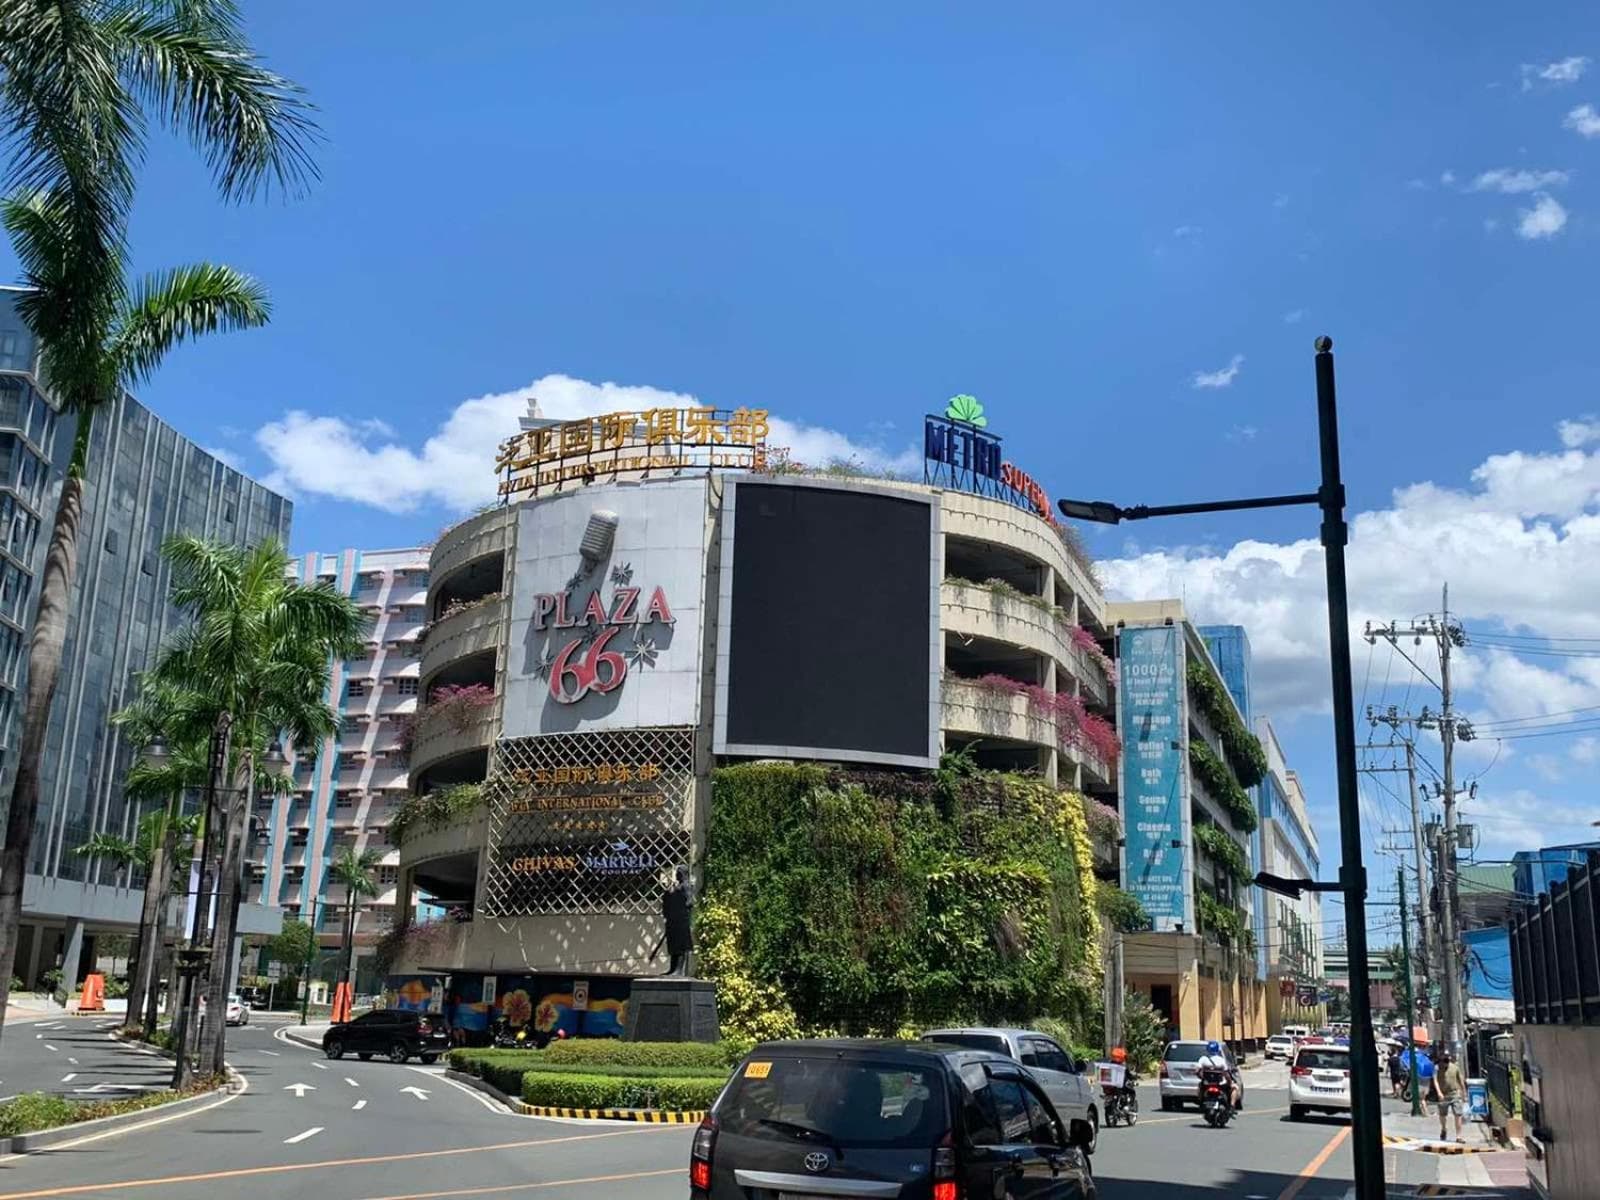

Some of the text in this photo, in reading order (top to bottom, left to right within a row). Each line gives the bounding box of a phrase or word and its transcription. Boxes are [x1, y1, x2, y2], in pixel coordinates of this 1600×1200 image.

[926, 421, 1001, 481] METRO
[532, 585, 676, 630] PLAZA
[549, 626, 628, 704] 66
[537, 795, 624, 811] INTERNATIONAL
[512, 854, 576, 871] CHIVAS
